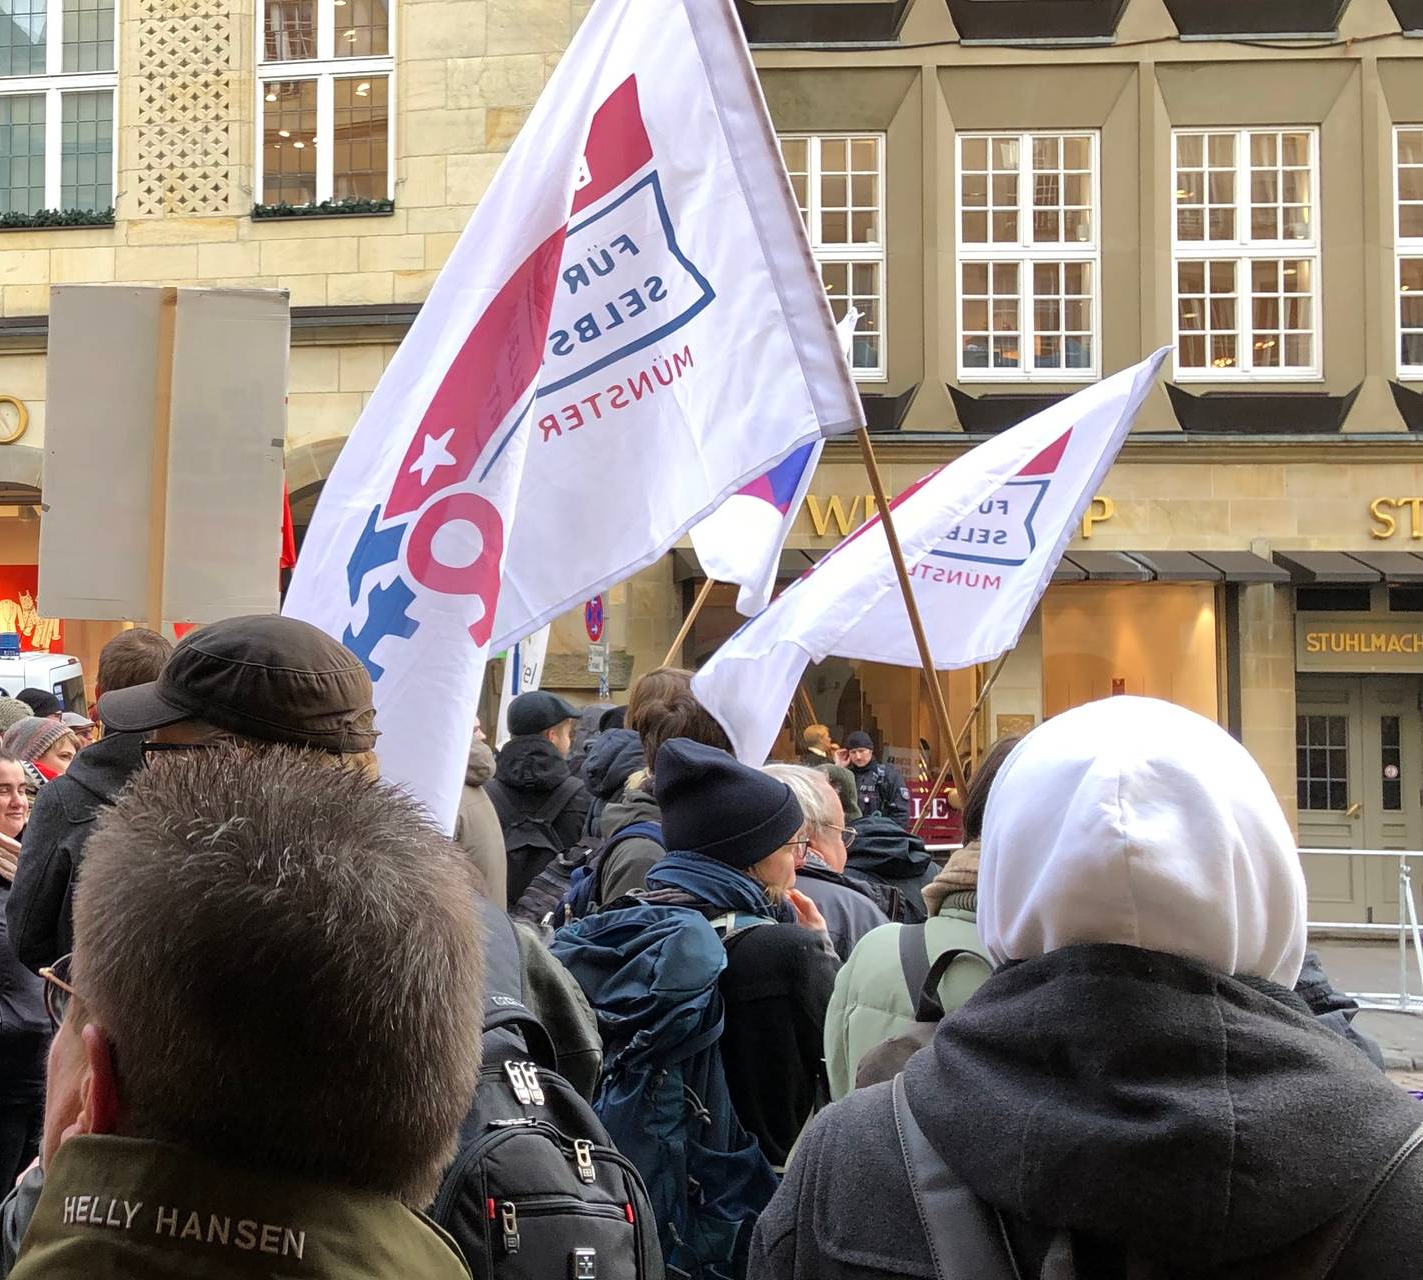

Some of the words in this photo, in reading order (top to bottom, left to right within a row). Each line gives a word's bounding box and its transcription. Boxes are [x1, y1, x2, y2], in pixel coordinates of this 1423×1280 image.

[1306, 632, 1423, 653] STUHLMACH
[63, 1195, 143, 1229] HELLY
[155, 1205, 306, 1260] HANSEN
